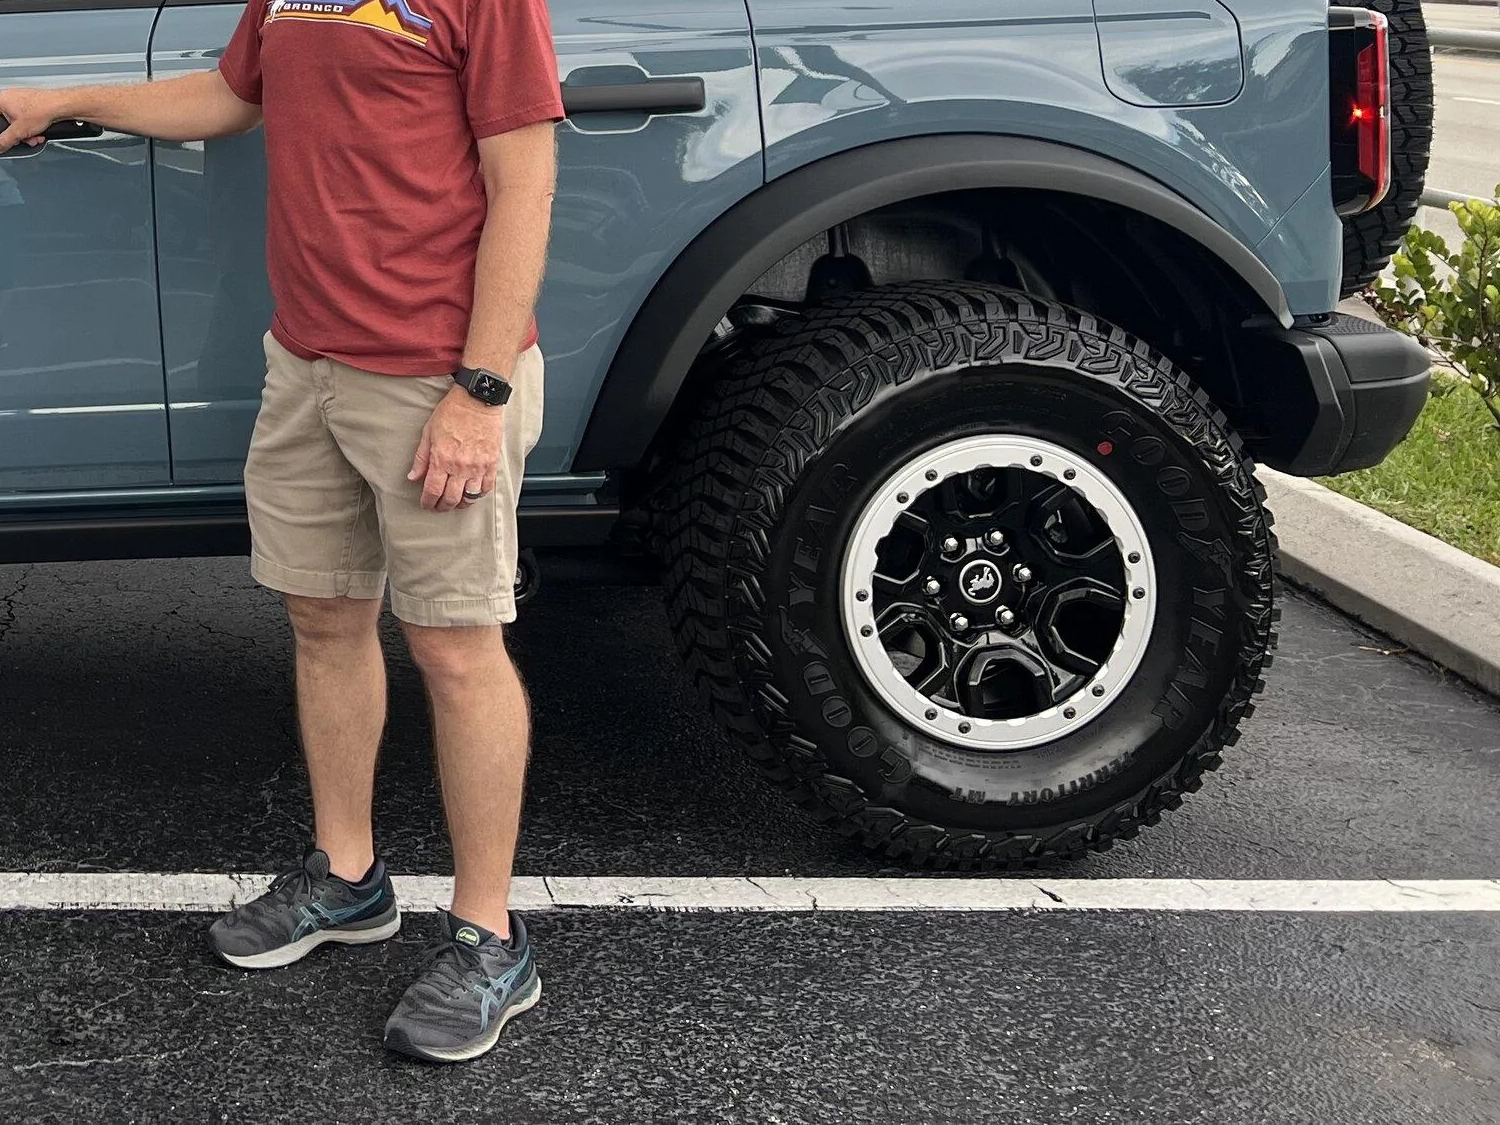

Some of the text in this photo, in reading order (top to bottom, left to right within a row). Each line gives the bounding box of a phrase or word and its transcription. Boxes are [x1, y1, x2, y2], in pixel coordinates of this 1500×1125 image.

[283, 2, 344, 13] BRONCO
[1006, 751, 1134, 806] TERRITORY
[949, 786, 987, 805] MT
